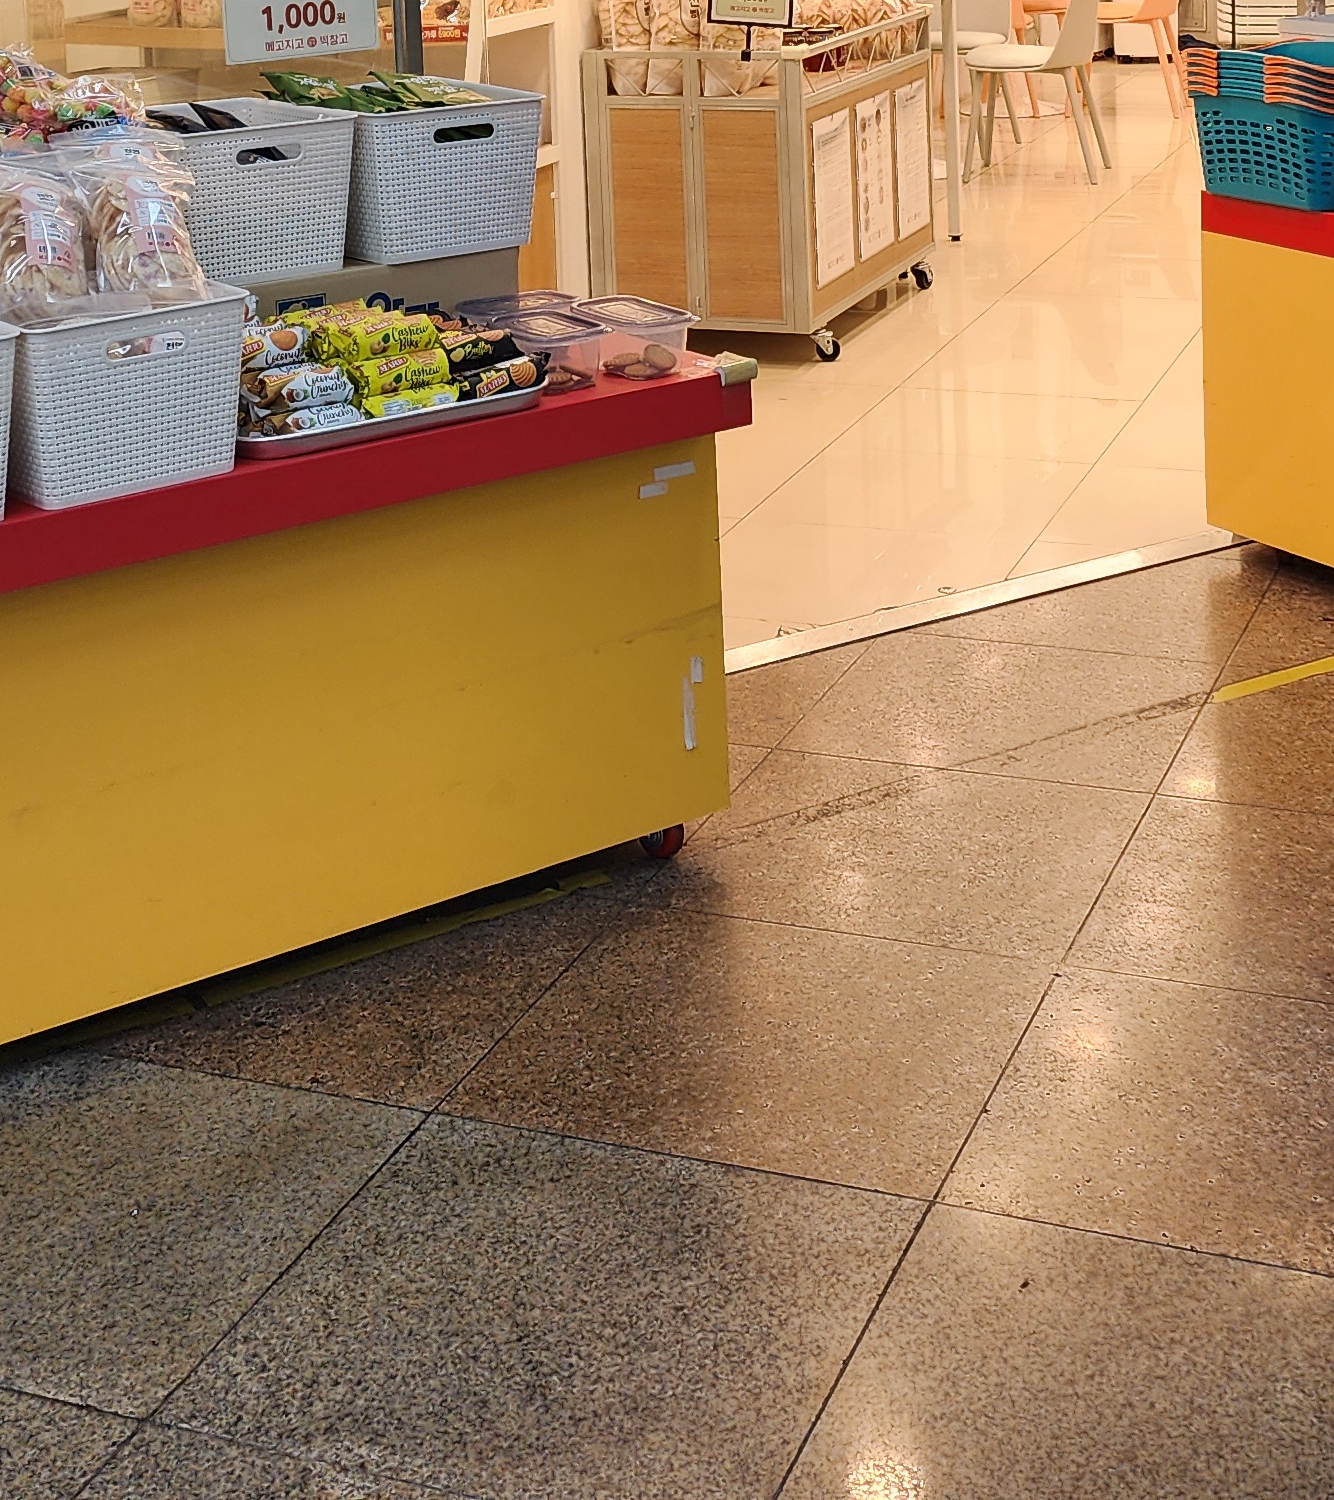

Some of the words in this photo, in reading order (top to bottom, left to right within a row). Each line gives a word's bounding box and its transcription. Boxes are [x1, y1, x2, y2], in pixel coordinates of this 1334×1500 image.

[265, 38, 304, 52] 메고지고
[379, 358, 407, 372] MARIO
[480, 375, 507, 394] MARIO
